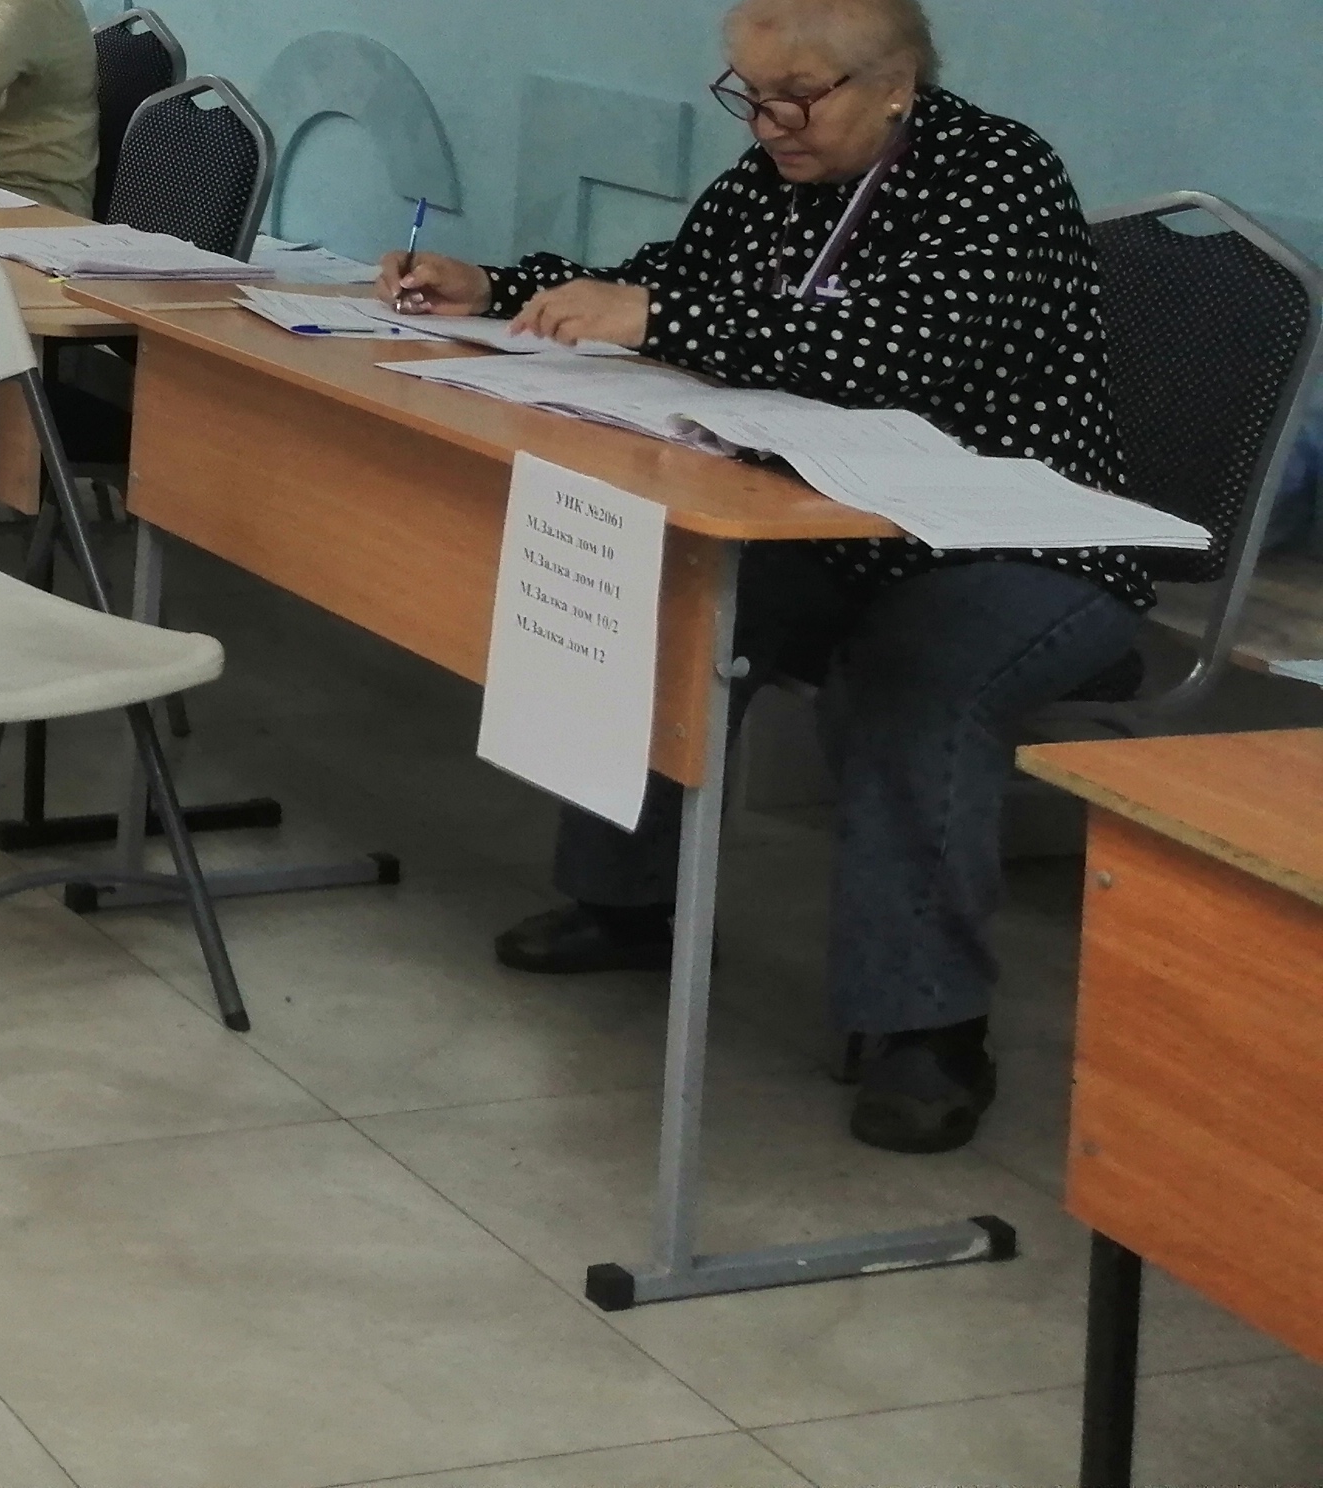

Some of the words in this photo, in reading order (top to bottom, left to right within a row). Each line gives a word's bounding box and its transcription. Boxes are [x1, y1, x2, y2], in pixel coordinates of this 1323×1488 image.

[555, 490, 584, 514] УИК
[585, 503, 623, 529] №2061
[575, 537, 597, 555] дом
[601, 544, 614, 560] 10
[572, 572, 595, 588] дом
[598, 579, 620, 600] 10/1
[571, 605, 593, 623] дом
[597, 613, 619, 634] 10/2
[567, 638, 590, 657] дом
[593, 647, 606, 664] 12
